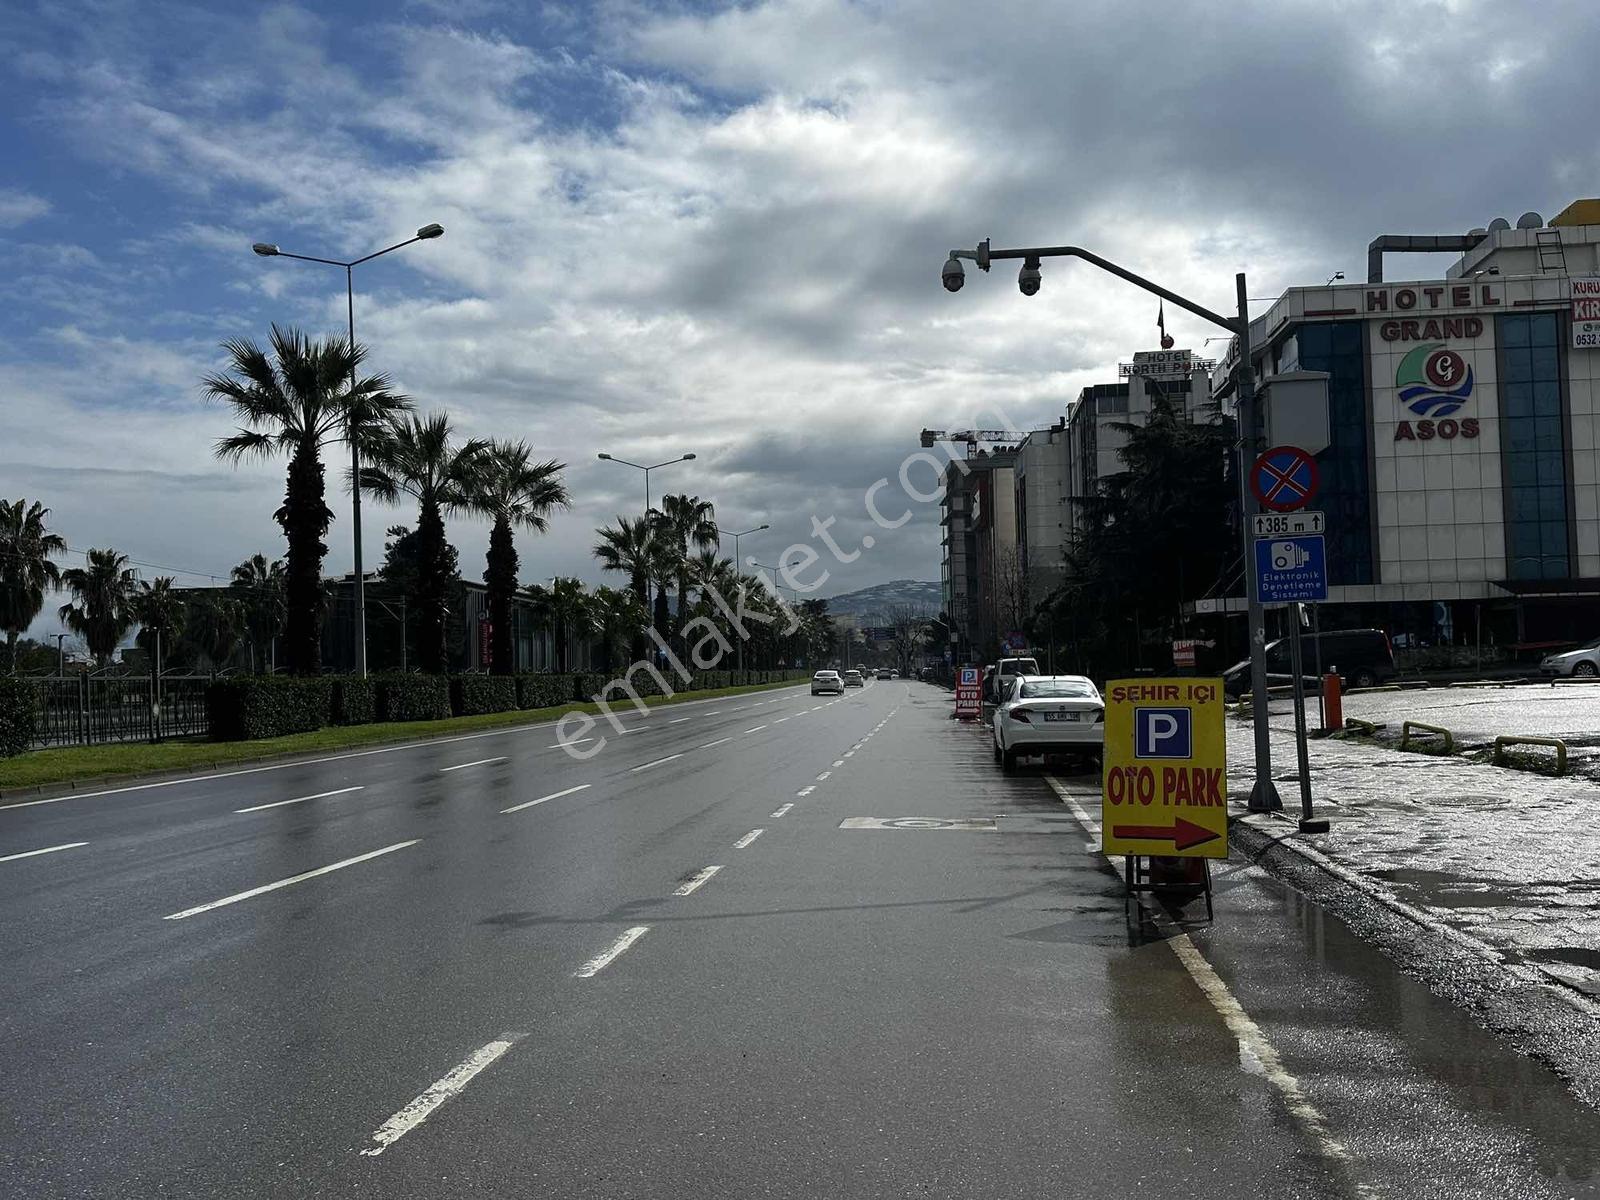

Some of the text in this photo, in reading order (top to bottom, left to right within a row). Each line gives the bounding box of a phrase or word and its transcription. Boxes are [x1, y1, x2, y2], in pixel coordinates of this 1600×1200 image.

[1367, 284, 1500, 311] HOTEL
[1380, 317, 1484, 342] GRAND
[1576, 334, 1597, 345] 0532
[1147, 352, 1188, 362] HOTEL
[1394, 418, 1480, 441] ASOS
[1266, 516, 1305, 532] 385 m
[1263, 571, 1320, 582] Elektronik
[1262, 582, 1322, 592] Denetleme
[1271, 591, 1314, 600] Sistemi
[957, 700, 980, 708] PARK
[1148, 713, 1178, 752] P
[1107, 766, 1224, 807] OTO PARK
